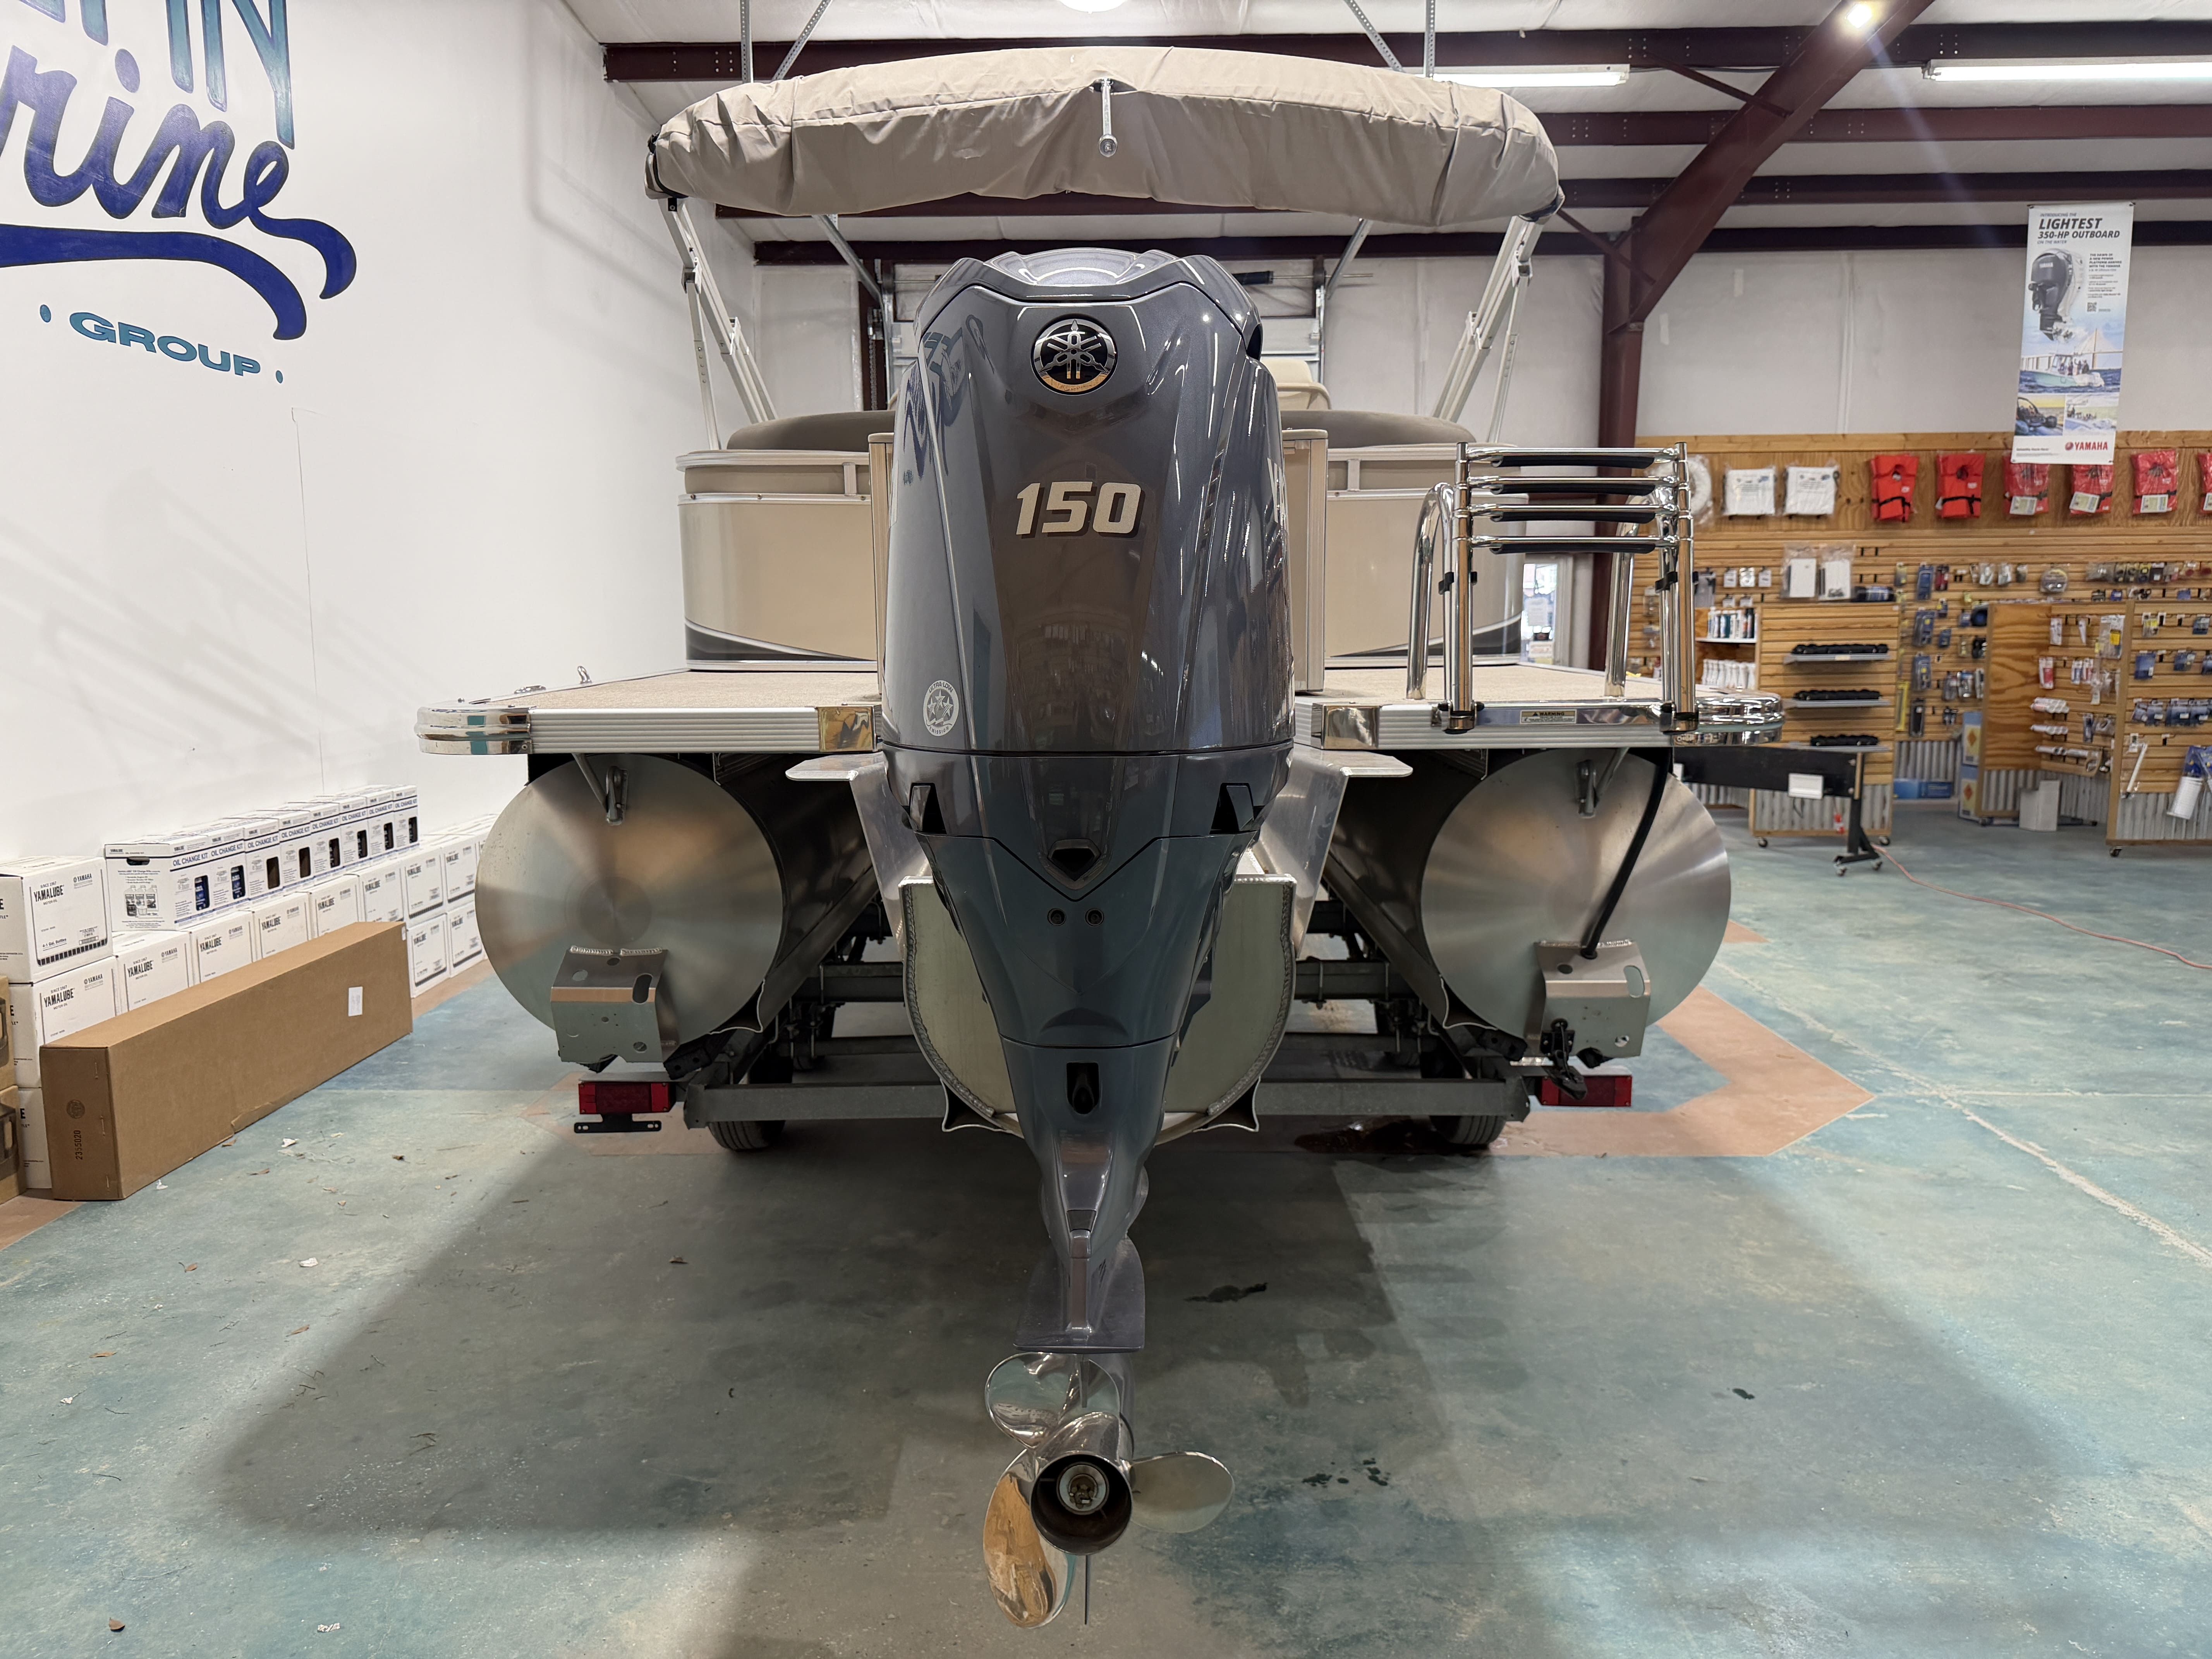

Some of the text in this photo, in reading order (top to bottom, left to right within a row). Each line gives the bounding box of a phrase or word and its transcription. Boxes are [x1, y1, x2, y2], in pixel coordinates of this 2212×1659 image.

[2039, 218, 2103, 230] LIGHTEST
[2038, 230, 2120, 239] 350-HP OUTBOARD
[69, 311, 261, 377] GROUP
[2075, 441, 2108, 450] YAMAHA
[1015, 481, 1144, 539] 150
[929, 726, 949, 734] EMISSION
[319, 819, 333, 828] CHANGE
[289, 828, 304, 836] CHANGE
[255, 838, 272, 847] CHANGE
[219, 845, 236, 855] CHANGE
[182, 854, 201, 864] CHANGE
[77, 873, 92, 881] YAMAHA
[34, 885, 64, 902] YAMALUBE
[199, 937, 222, 952] YAMALUBE
[165, 948, 177, 957] YAMAHA
[127, 960, 153, 977] YAMALUBE
[88, 974, 103, 983] YAMAHA
[44, 988, 74, 1008] YAMALUBE
[73, 1130, 83, 1160] 2355020
